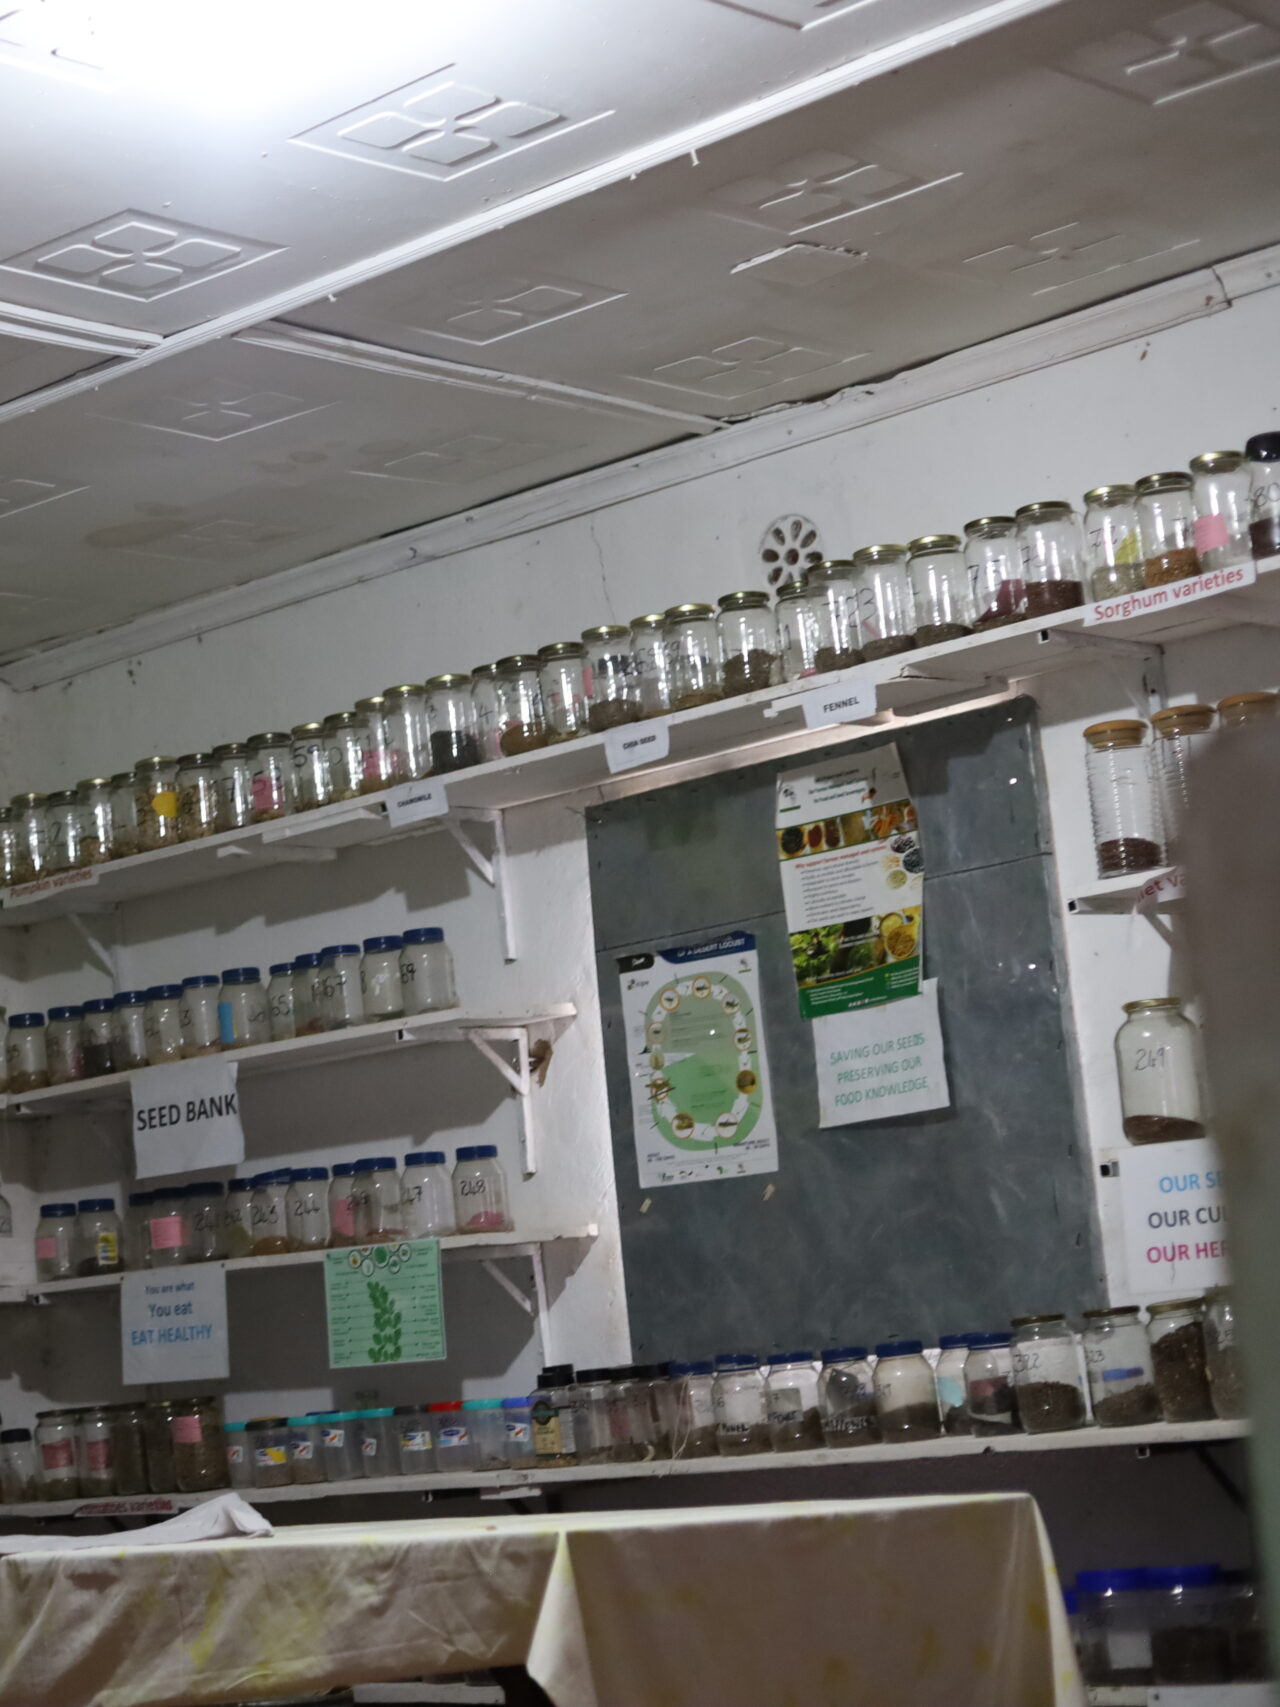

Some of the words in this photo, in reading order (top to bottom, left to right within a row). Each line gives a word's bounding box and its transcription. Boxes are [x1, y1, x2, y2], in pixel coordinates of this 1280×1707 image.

[1094, 590, 1169, 621] Sorghum
[1172, 568, 1245, 598] varieties
[823, 696, 861, 714] FENNEL
[830, 1045, 870, 1066] SAVING
[872, 1040, 895, 1056] OUR
[837, 1061, 899, 1084] PRESERVING
[901, 1056, 922, 1071] OUR
[834, 1090, 863, 1107] FOOD
[865, 1076, 929, 1099] KNOWLEDGE
[137, 1104, 181, 1131] SEED
[186, 1093, 238, 1122] BANK
[1159, 1173, 1201, 1194] OUR
[1148, 1210, 1191, 1229] OUR
[1147, 1244, 1190, 1263] OUR
[148, 1303, 171, 1318] You
[174, 1302, 193, 1316] eat
[131, 1329, 154, 1345] EAT
[158, 1325, 213, 1343] HEALTHY
